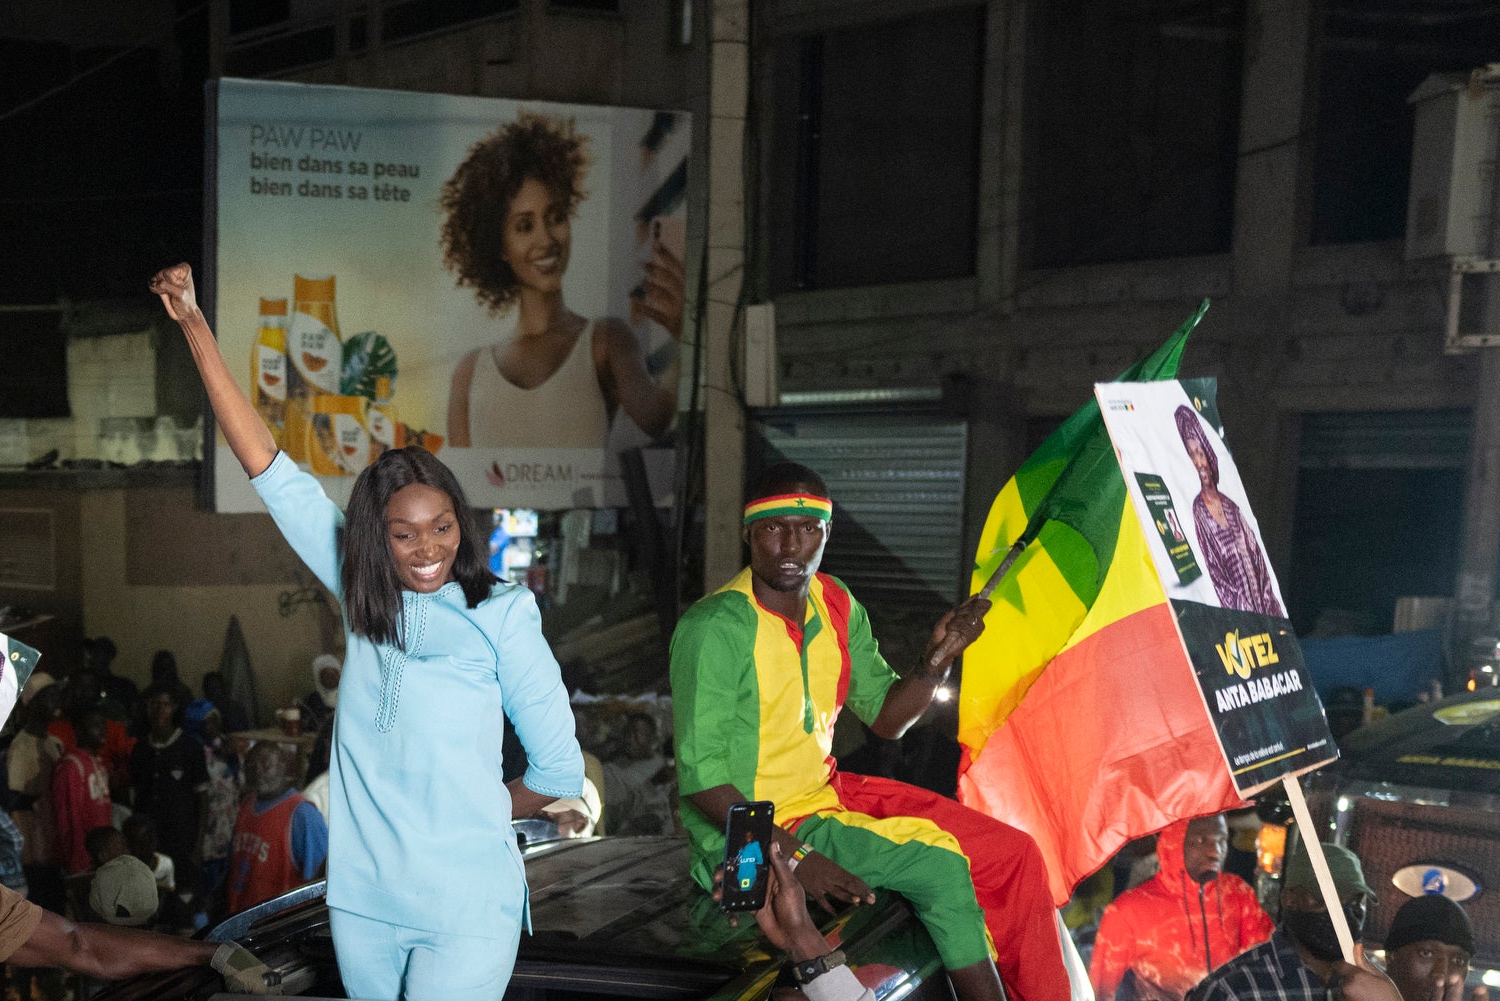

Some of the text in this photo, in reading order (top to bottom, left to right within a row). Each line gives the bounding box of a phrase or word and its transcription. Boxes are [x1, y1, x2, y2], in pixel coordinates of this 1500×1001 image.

[251, 124, 363, 152] PAW PAW
[251, 152, 420, 180] bien dans sa peau
[251, 177, 411, 202] bien dans sa tête
[506, 463, 573, 482] DREAM
[1215, 628, 1279, 679] VOTEZ
[1215, 669, 1303, 713] ANTA BABACAR
